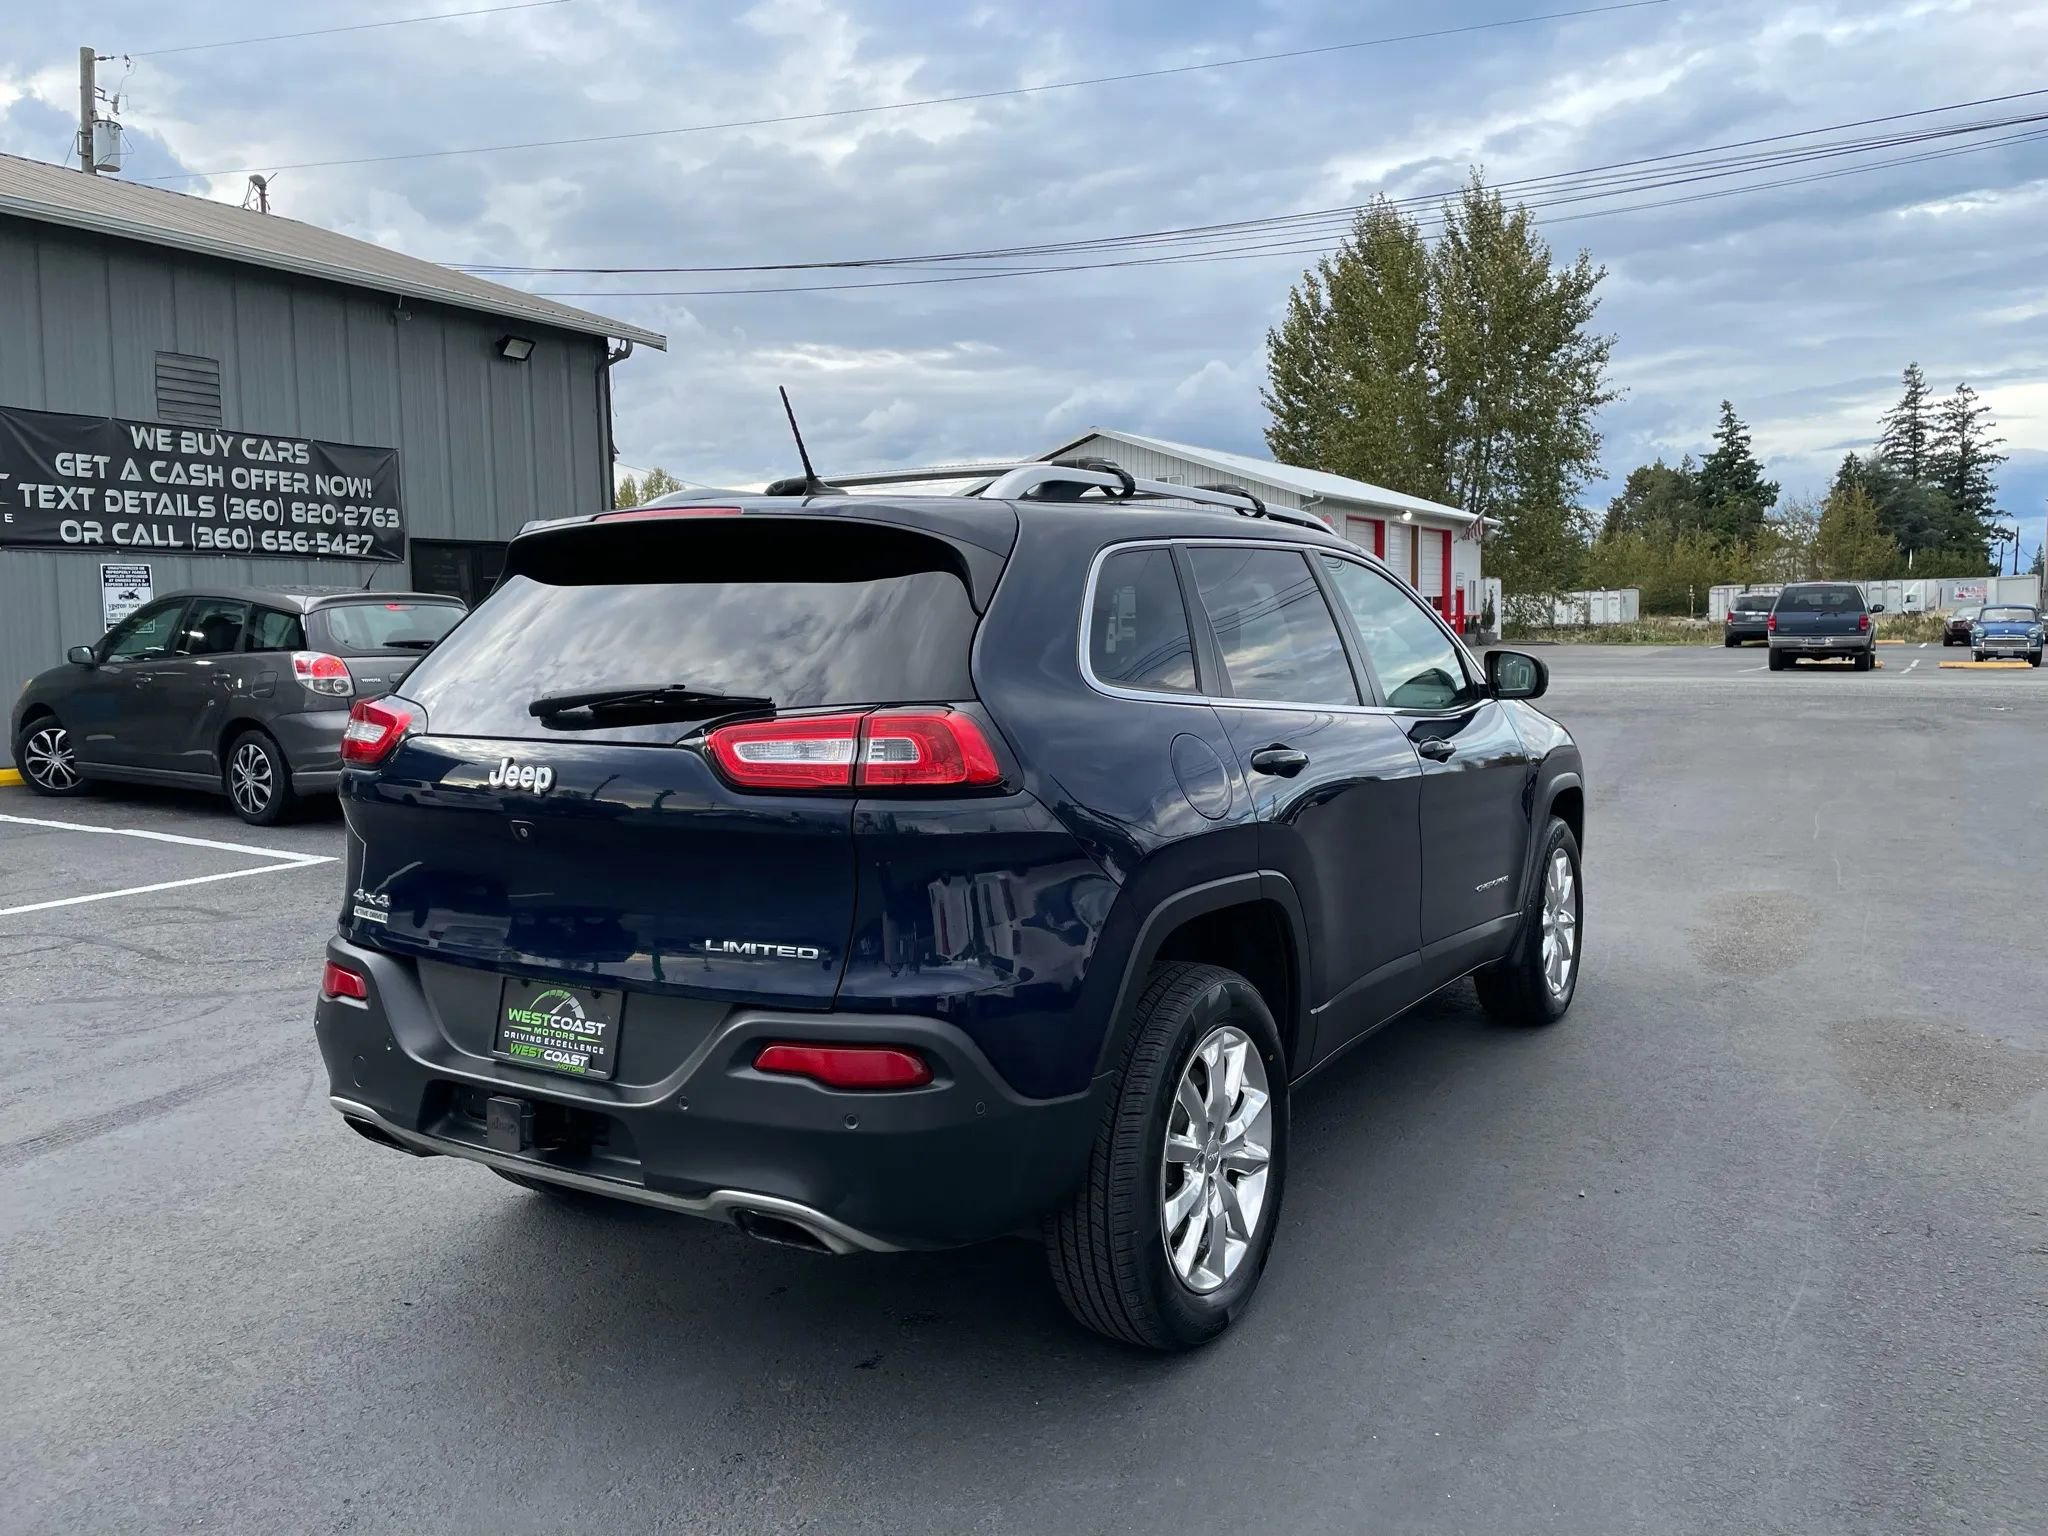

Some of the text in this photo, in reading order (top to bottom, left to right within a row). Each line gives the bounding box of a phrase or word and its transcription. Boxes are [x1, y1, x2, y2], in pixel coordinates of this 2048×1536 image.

[130, 425, 310, 465] WE BUY CARS
[55, 452, 373, 499] GET A CASH OFFER NOW!
[17, 482, 400, 528] TEXT DETAILS (360) 820-2763
[60, 519, 374, 555] OR CALL (360) 656-5427
[488, 757, 553, 794] Jeep
[705, 939, 819, 960] LIMITED
[504, 1030, 605, 1055] DRIVING EXCELLENCE
[533, 1027, 575, 1041] MOTORS
